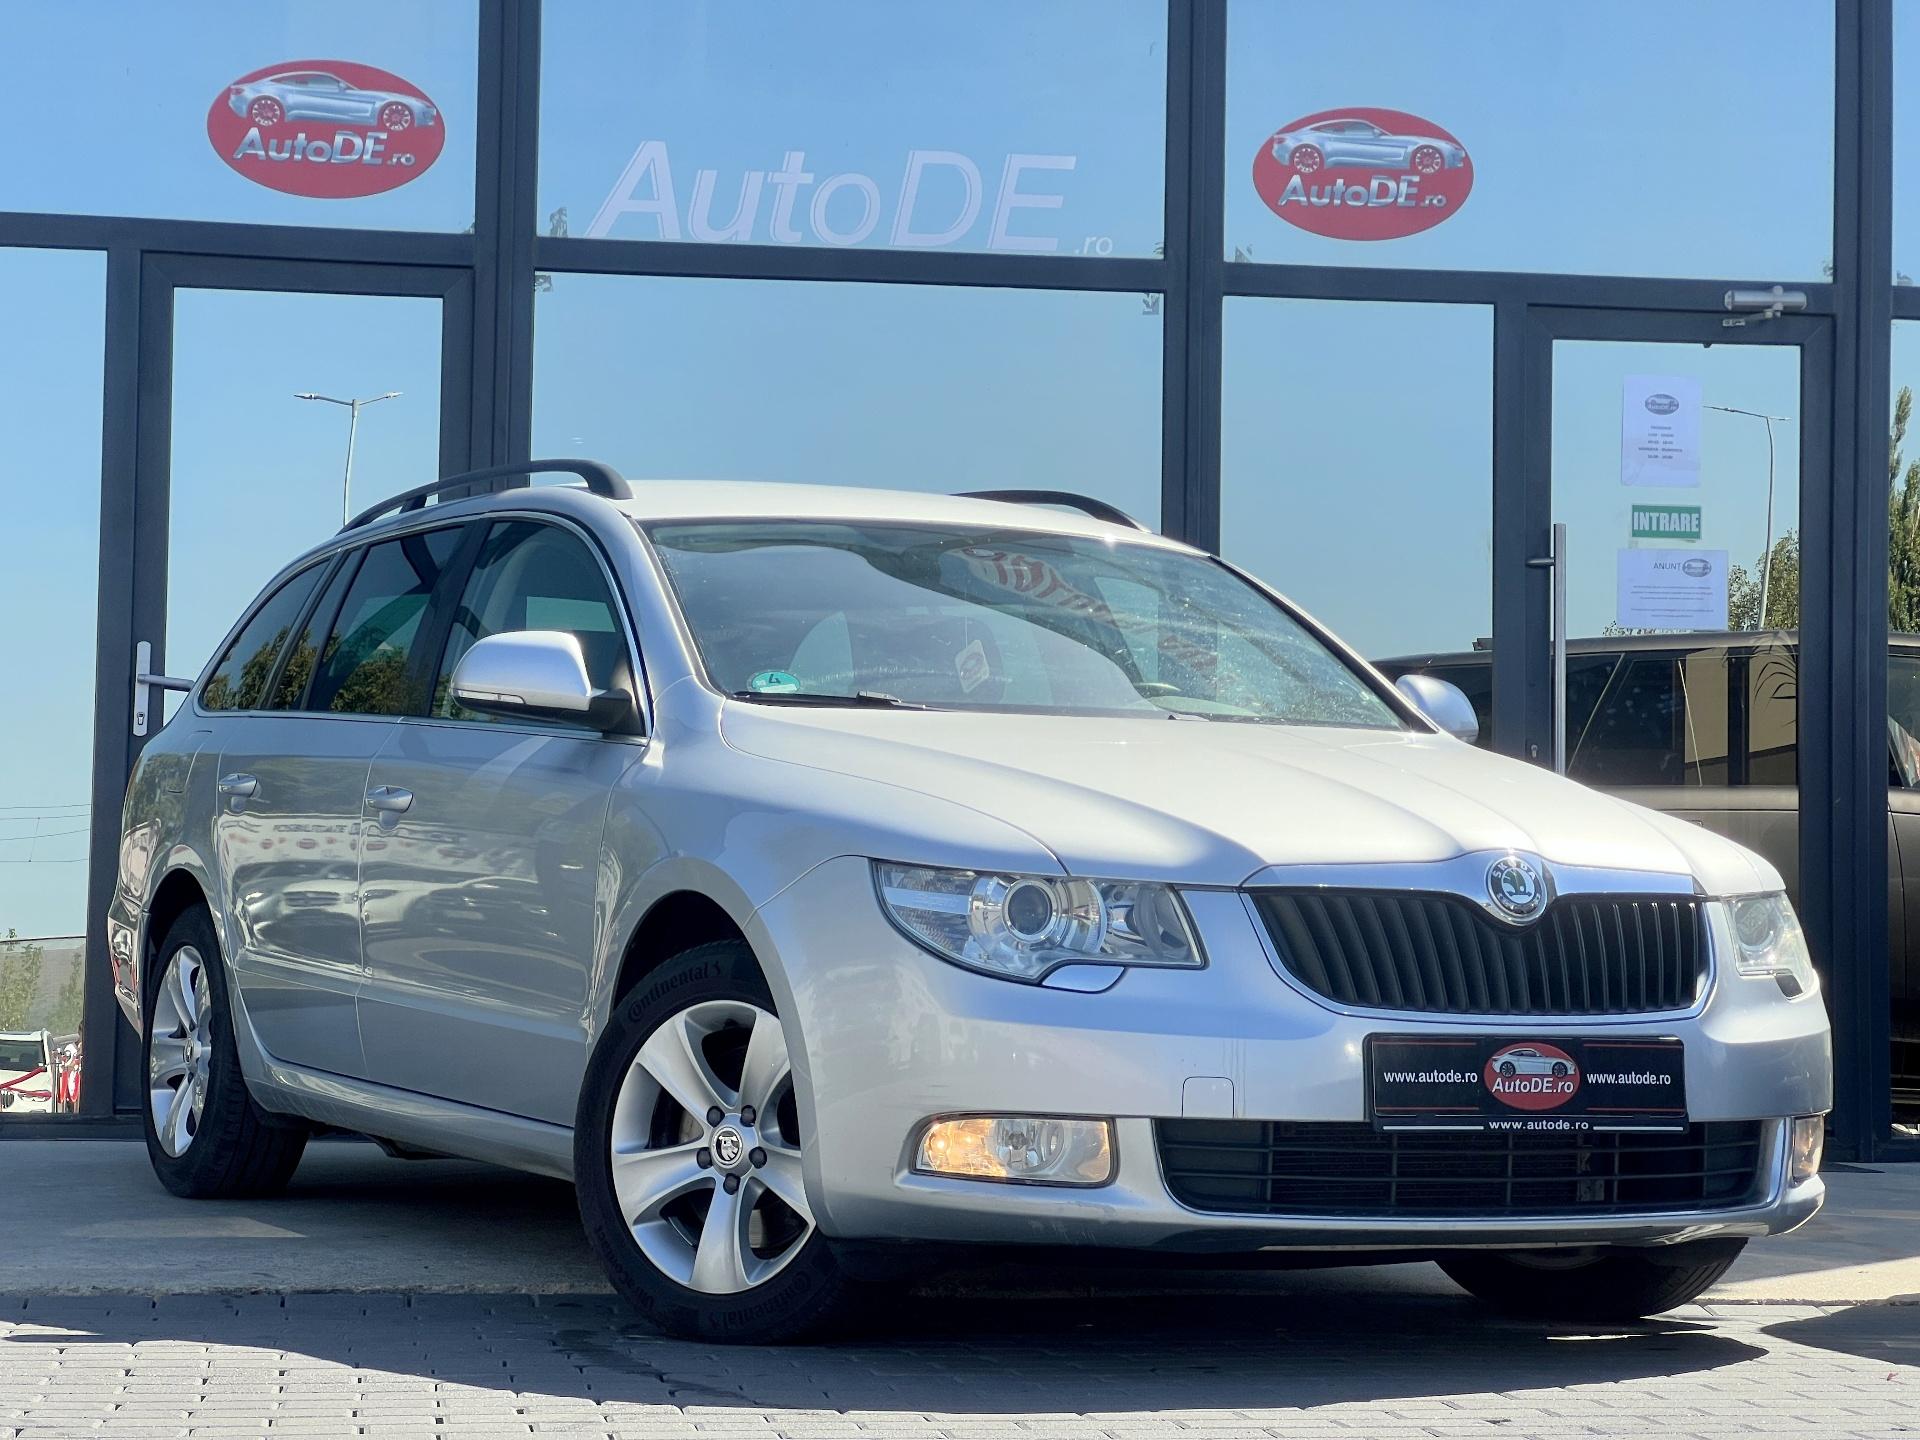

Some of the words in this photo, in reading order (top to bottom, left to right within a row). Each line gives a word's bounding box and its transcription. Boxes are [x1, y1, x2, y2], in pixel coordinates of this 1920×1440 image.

[1633, 511, 1700, 532] INTRARE
[1383, 1069, 1478, 1083] www.autode.ro
[1586, 1071, 1671, 1085] www.autode.ro
[1491, 1077, 1574, 1093] AutoDE.ro
[1489, 1120, 1589, 1130] www.autode.ro
